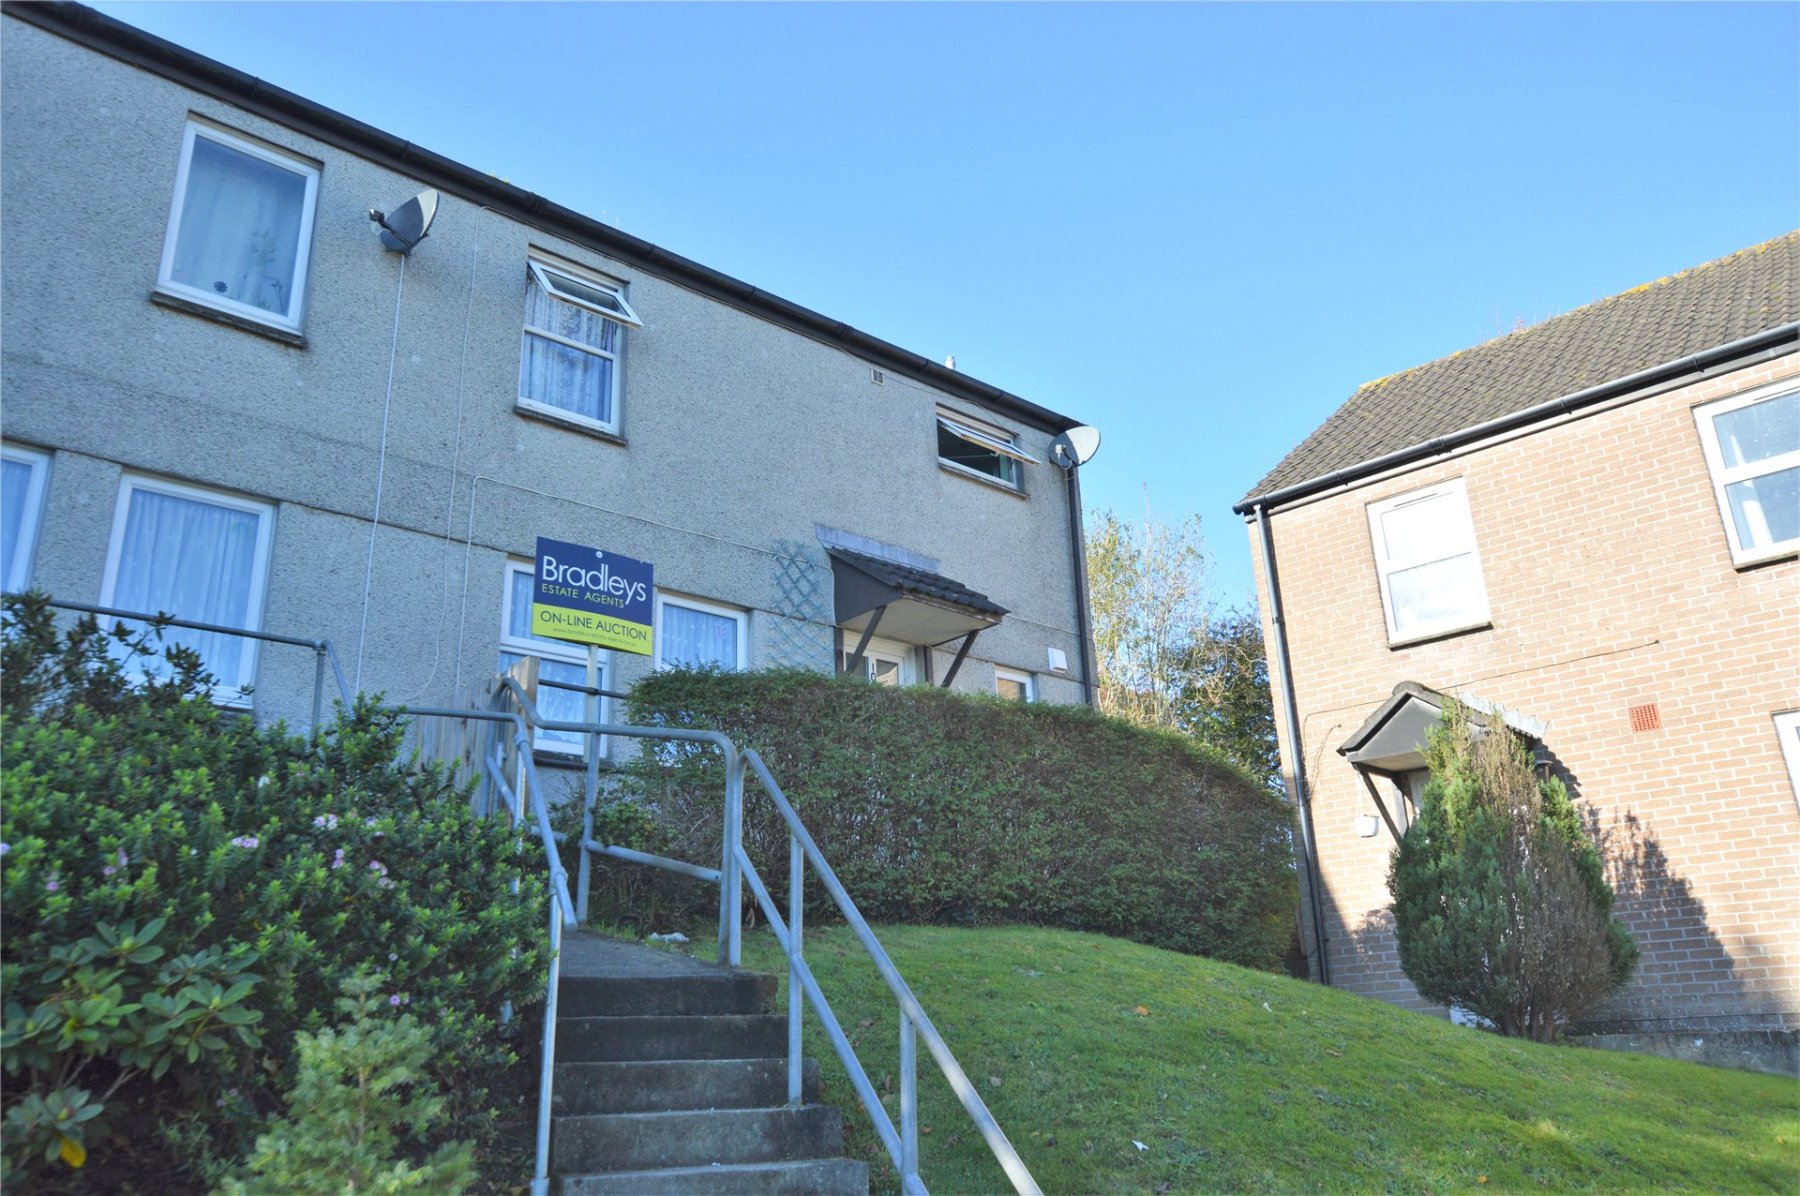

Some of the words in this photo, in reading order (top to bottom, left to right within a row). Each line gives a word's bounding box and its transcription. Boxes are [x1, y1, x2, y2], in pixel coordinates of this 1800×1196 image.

[542, 555, 646, 605] Bradleys
[541, 583, 579, 599] ESTATE
[584, 591, 625, 609] AGENTS
[540, 610, 593, 629] ON-LINE
[595, 621, 647, 641] AUCTION
